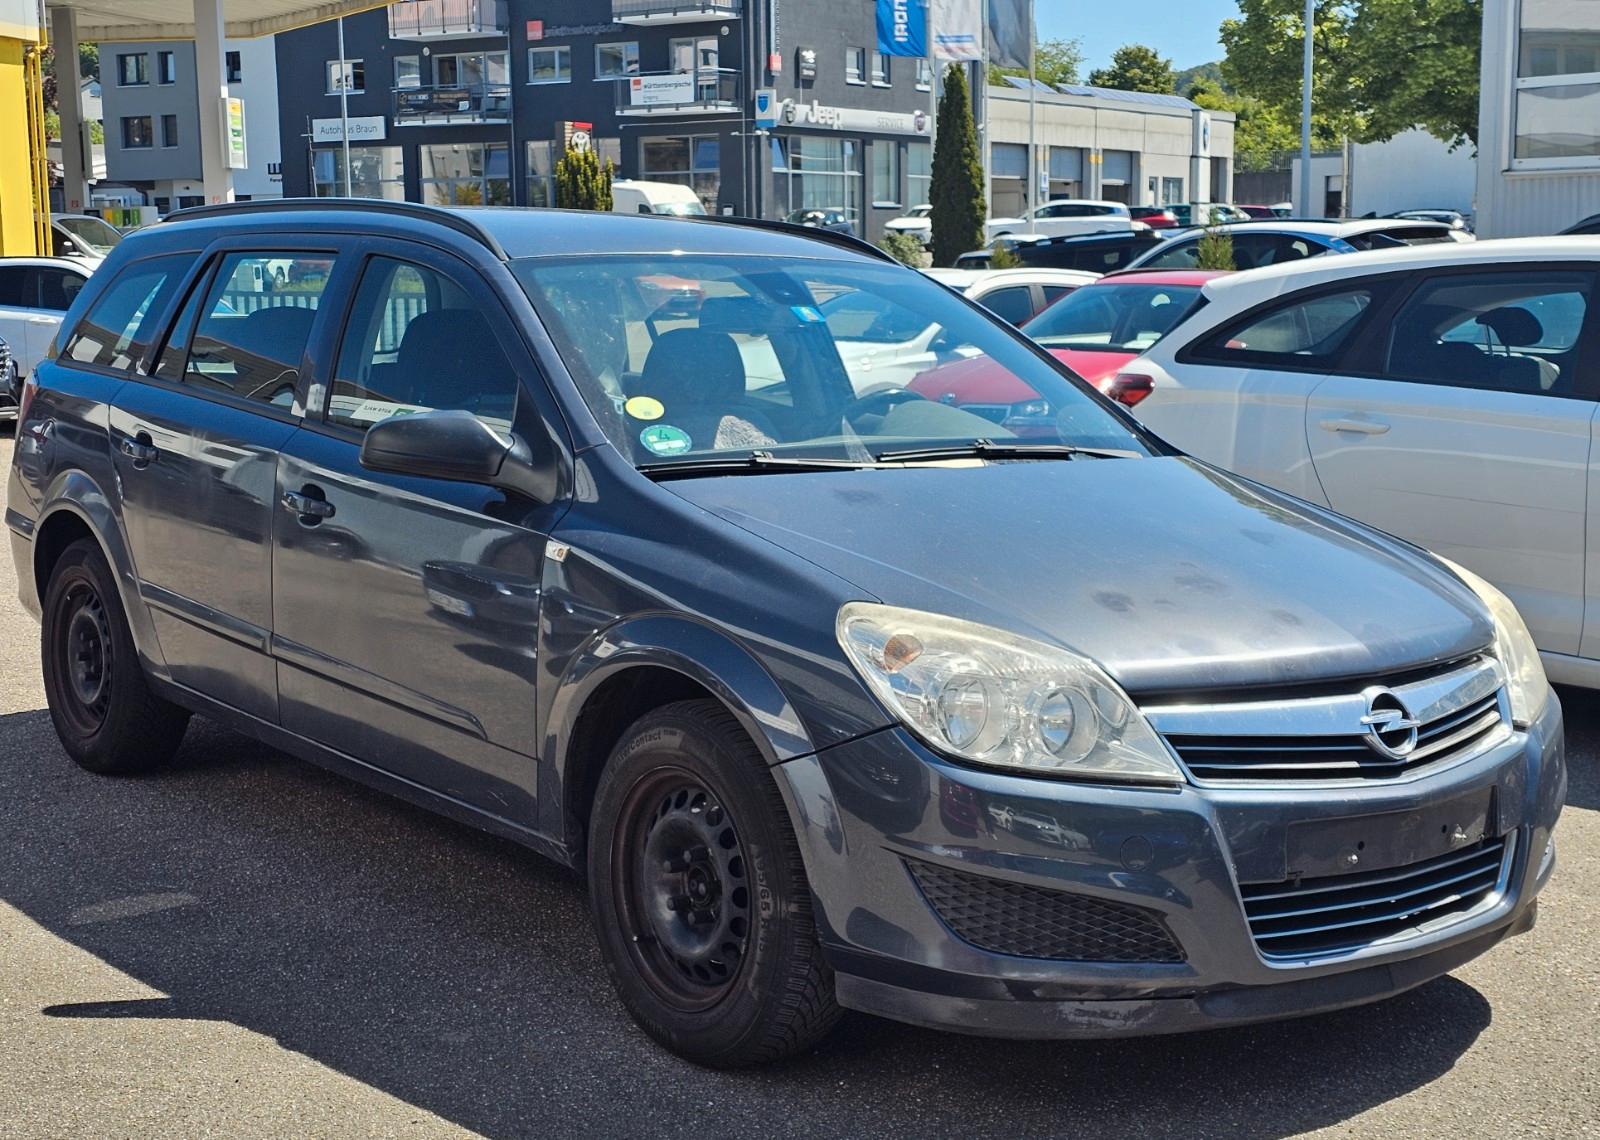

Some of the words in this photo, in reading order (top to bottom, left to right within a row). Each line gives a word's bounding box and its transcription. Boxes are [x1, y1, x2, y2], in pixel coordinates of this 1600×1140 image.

[806, 99, 840, 130] Jeep
[320, 125, 354, 136] Autohus
[356, 124, 378, 134] Braun
[659, 429, 671, 440] 4
